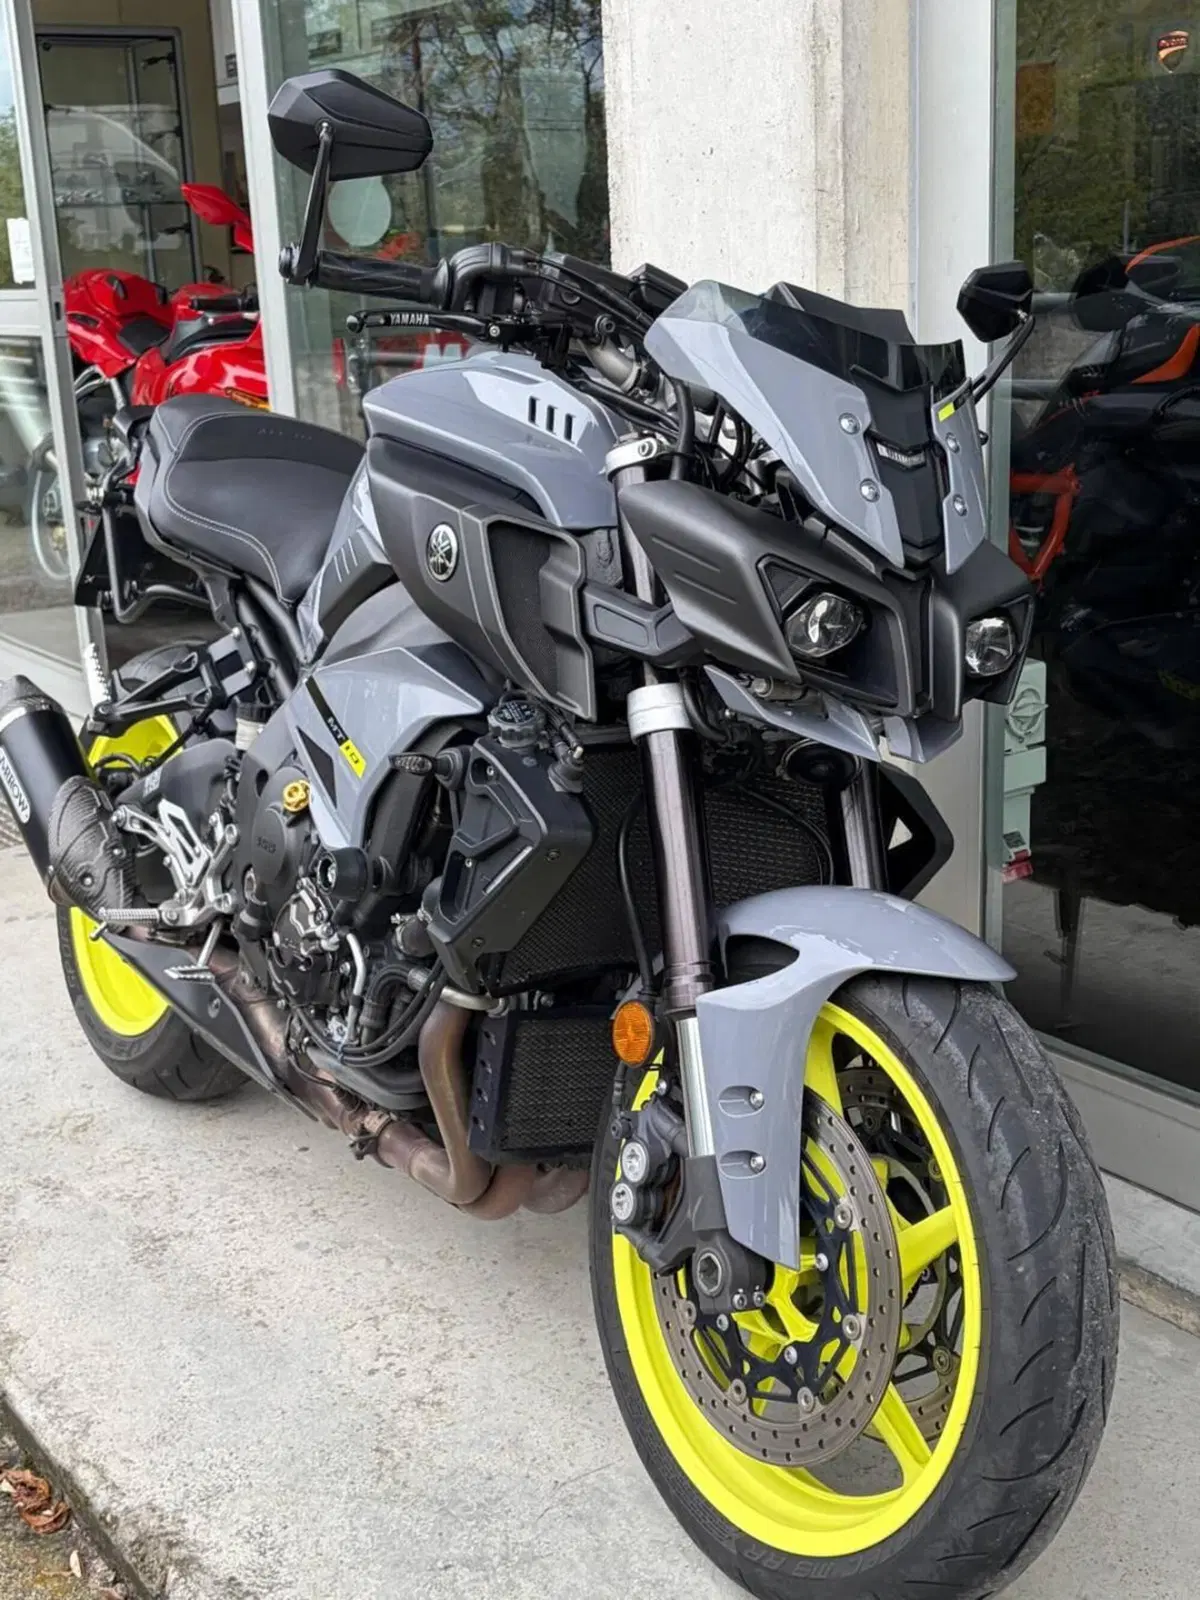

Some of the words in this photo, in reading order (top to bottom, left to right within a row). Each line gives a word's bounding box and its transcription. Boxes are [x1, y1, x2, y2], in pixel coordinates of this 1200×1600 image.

[389, 313, 430, 326] YAMAHA
[327, 716, 346, 741] MT
[345, 744, 360, 765] 10
